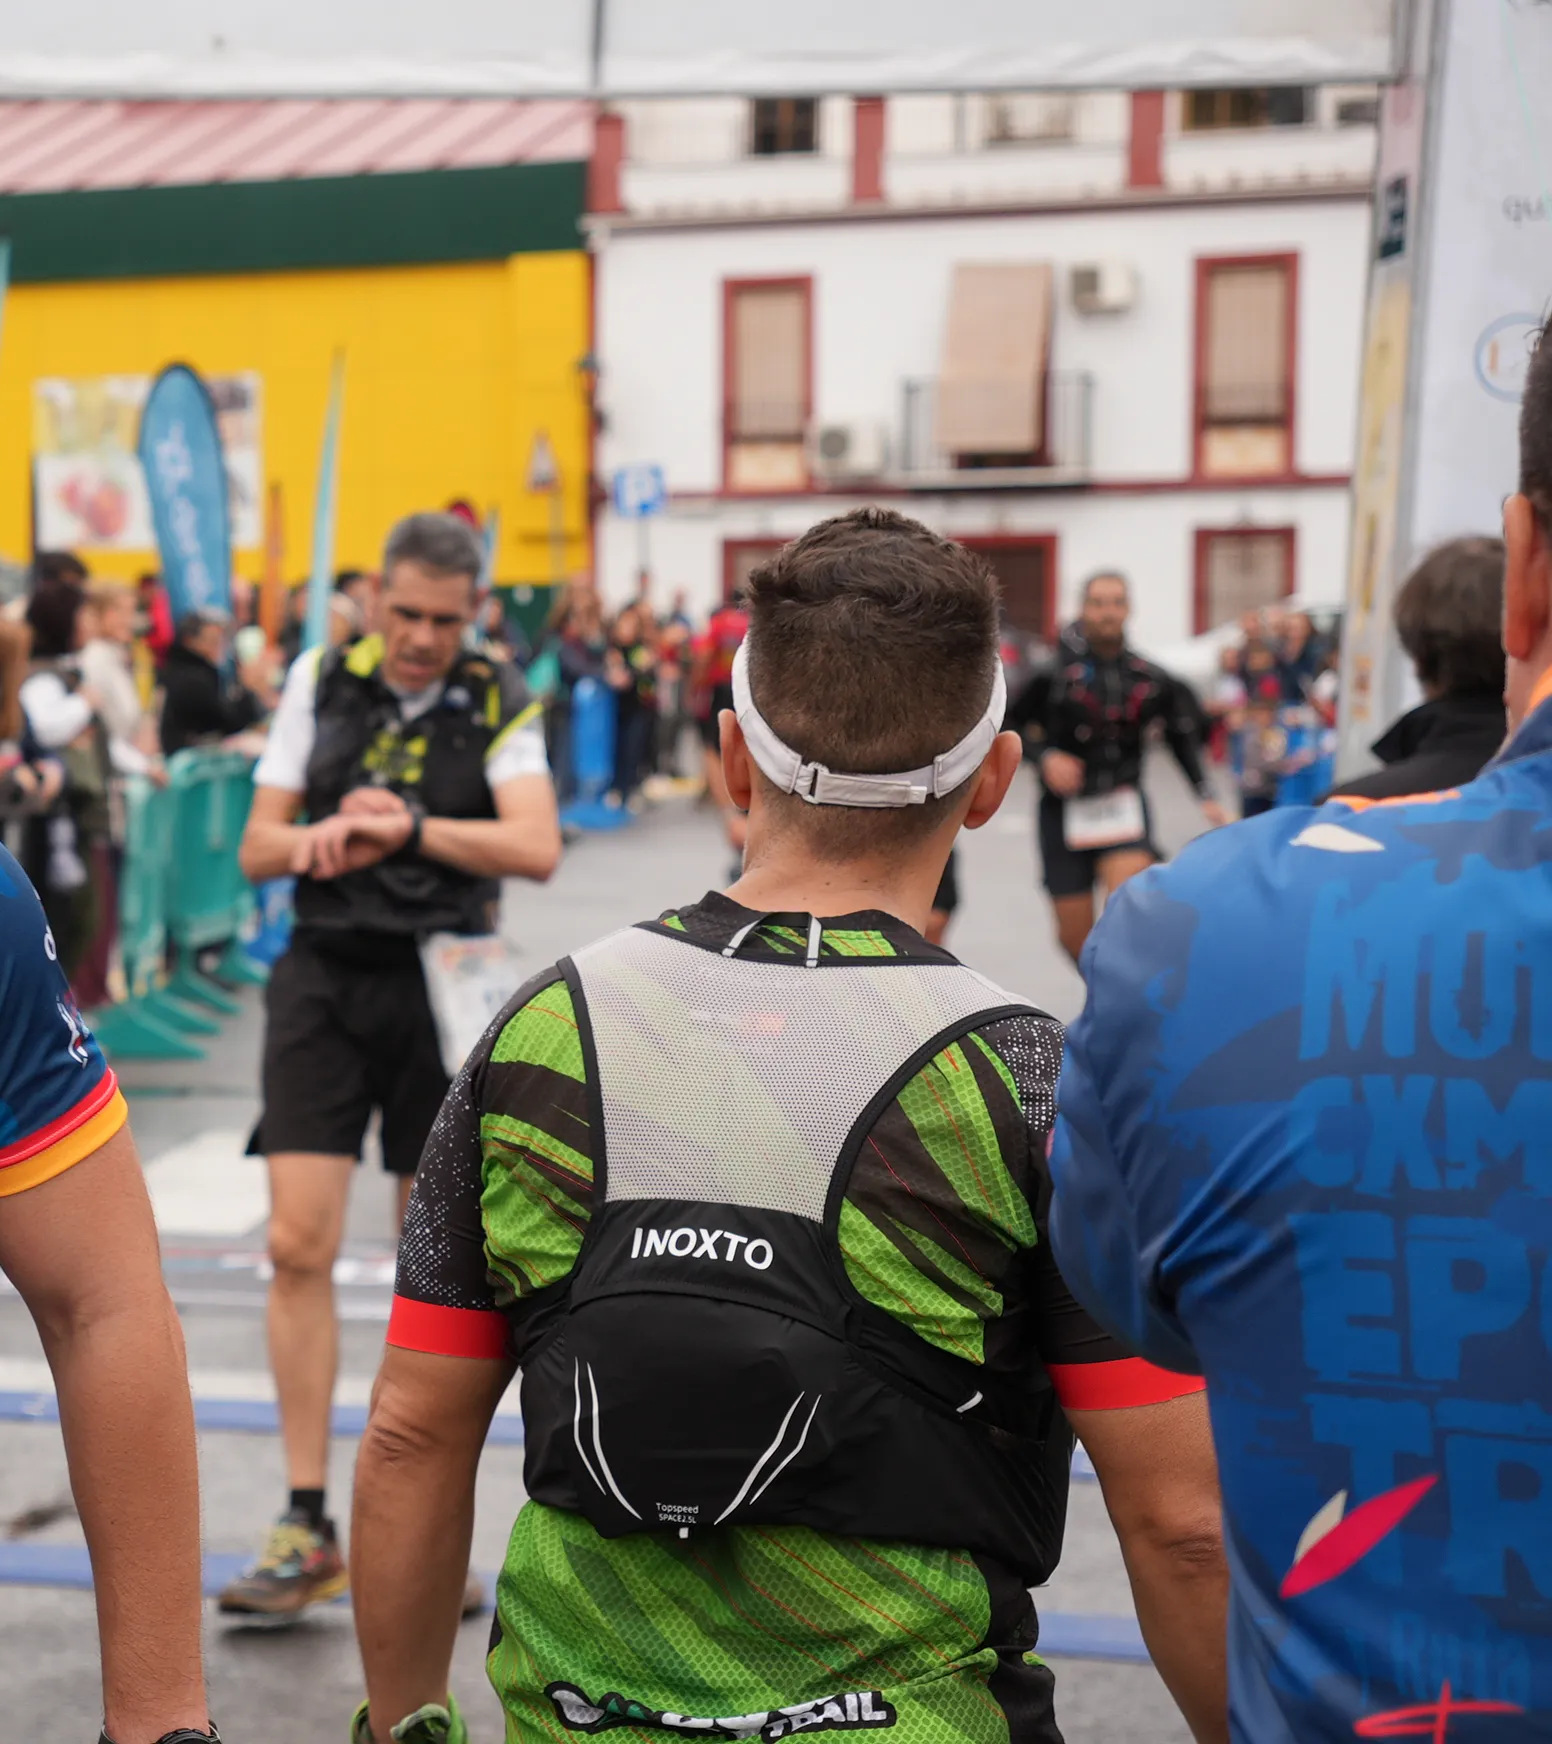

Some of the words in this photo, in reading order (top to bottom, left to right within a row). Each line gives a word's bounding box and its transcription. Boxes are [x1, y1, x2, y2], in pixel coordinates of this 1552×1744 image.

[1298, 880, 1552, 1063] MO
[631, 1227, 774, 1270] INOXTO
[1286, 1210, 1552, 1384] EP
[655, 1502, 699, 1514] Topspeed
